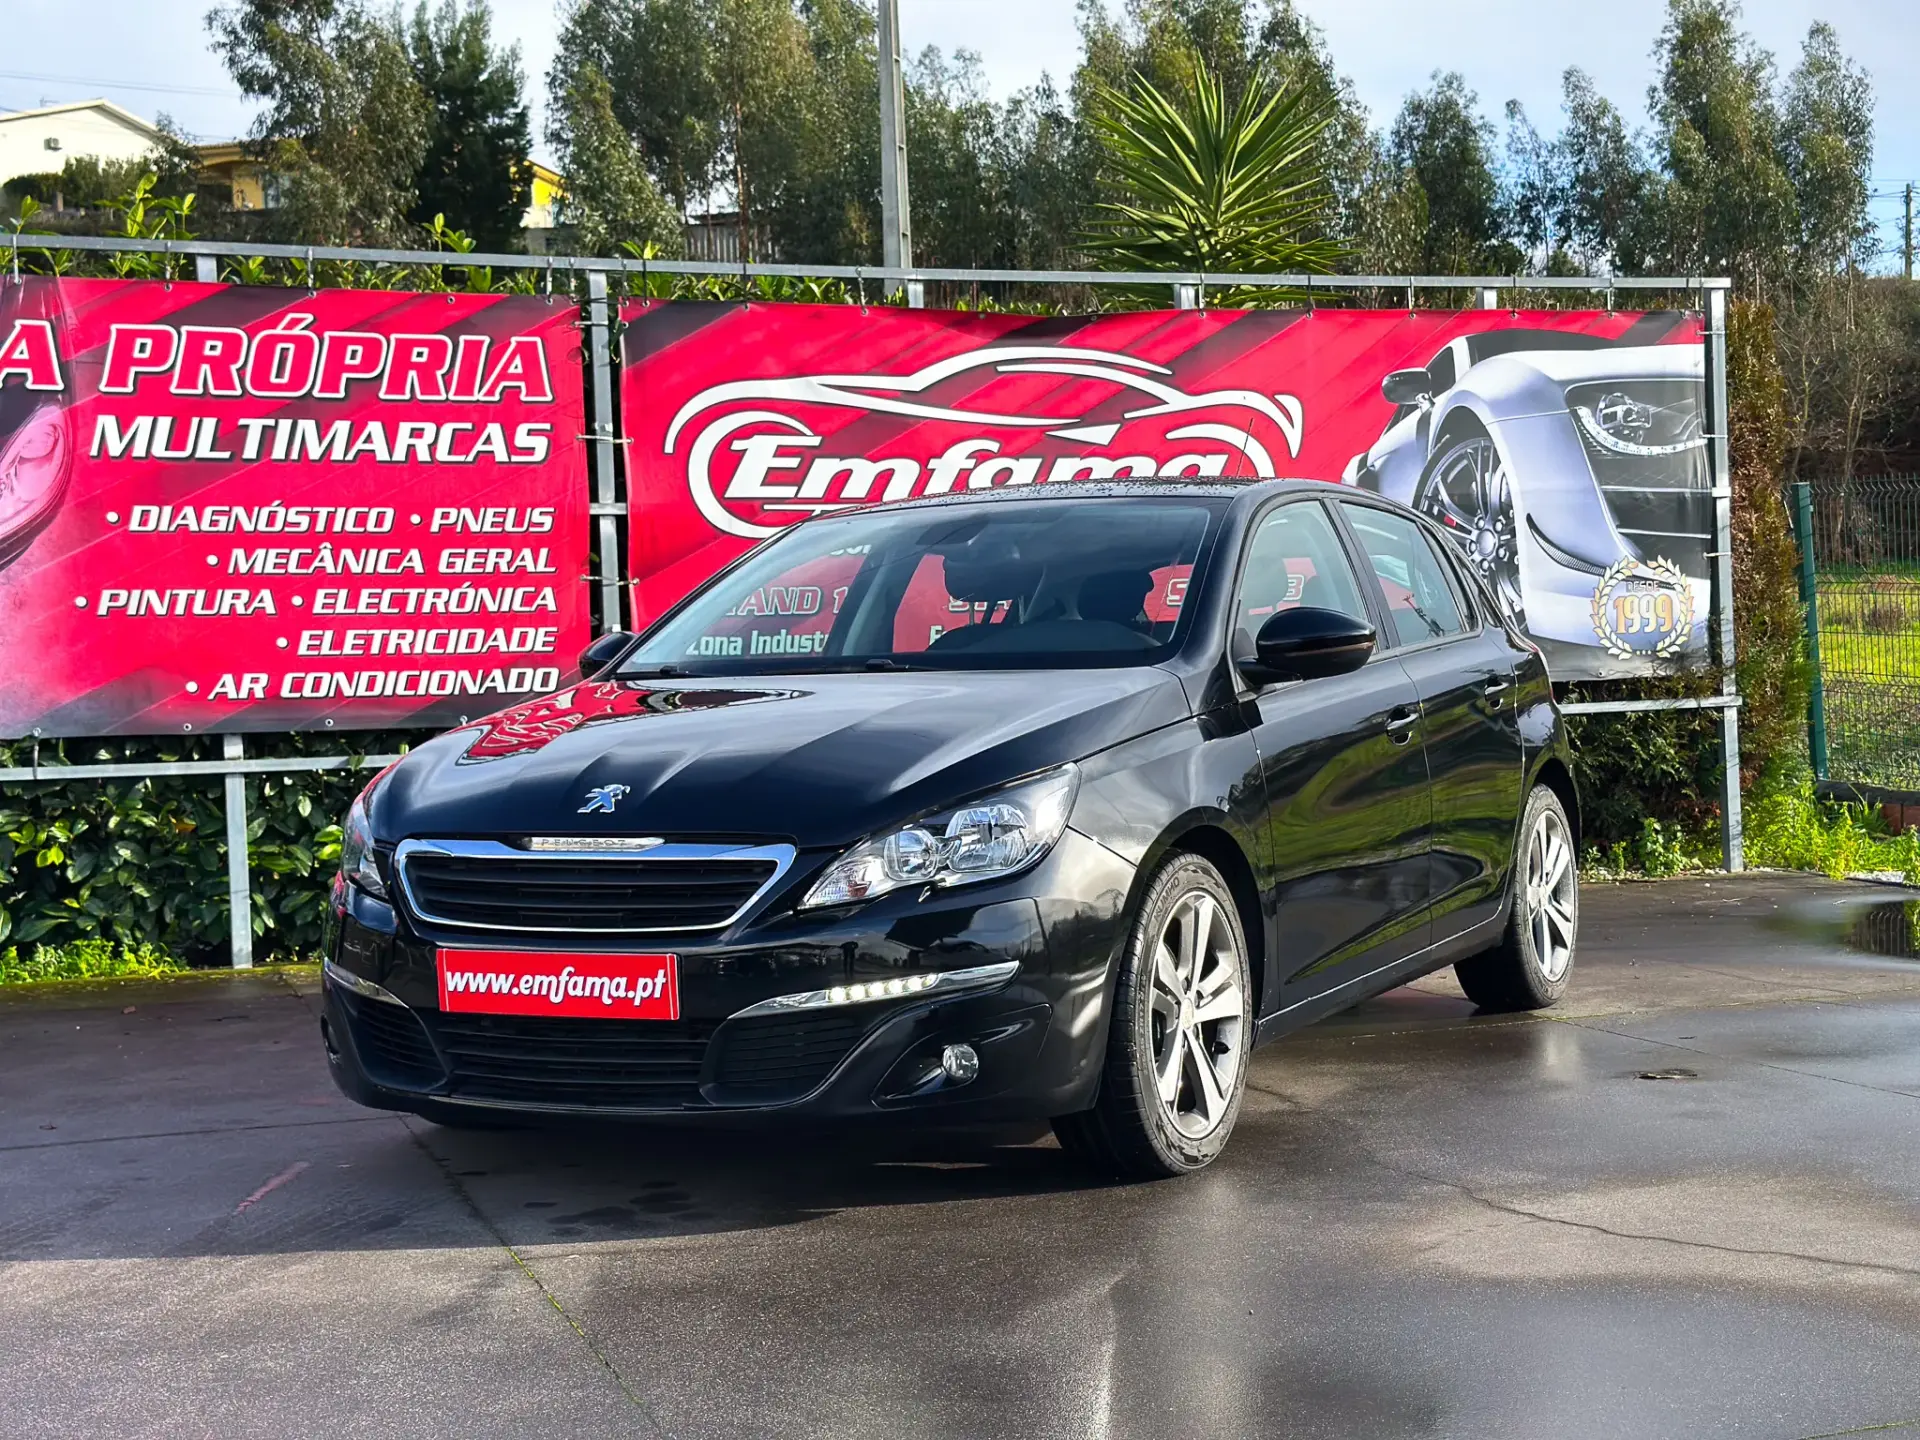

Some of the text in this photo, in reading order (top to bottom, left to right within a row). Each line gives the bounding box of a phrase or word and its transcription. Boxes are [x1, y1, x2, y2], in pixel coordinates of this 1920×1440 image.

[0, 313, 553, 402] A PRÓPRIA
[90, 414, 551, 463] MULTIMARCAS
[129, 501, 554, 533] DIAGNÓSTICO PNEUS
[228, 542, 556, 574] MECÂNICA GERAL
[97, 583, 556, 615] PINTURA ELECTRÓNICA
[726, 586, 822, 616] AND
[1626, 581, 1660, 593] DESDE
[1613, 594, 1673, 634] 1999
[297, 627, 556, 655] ELETRICIDADE
[749, 629, 830, 655] Indust
[207, 667, 558, 700] AR CONDICIONADO
[541, 838, 626, 847] PEUGEOT
[446, 966, 667, 1006] www.emfama.pt
